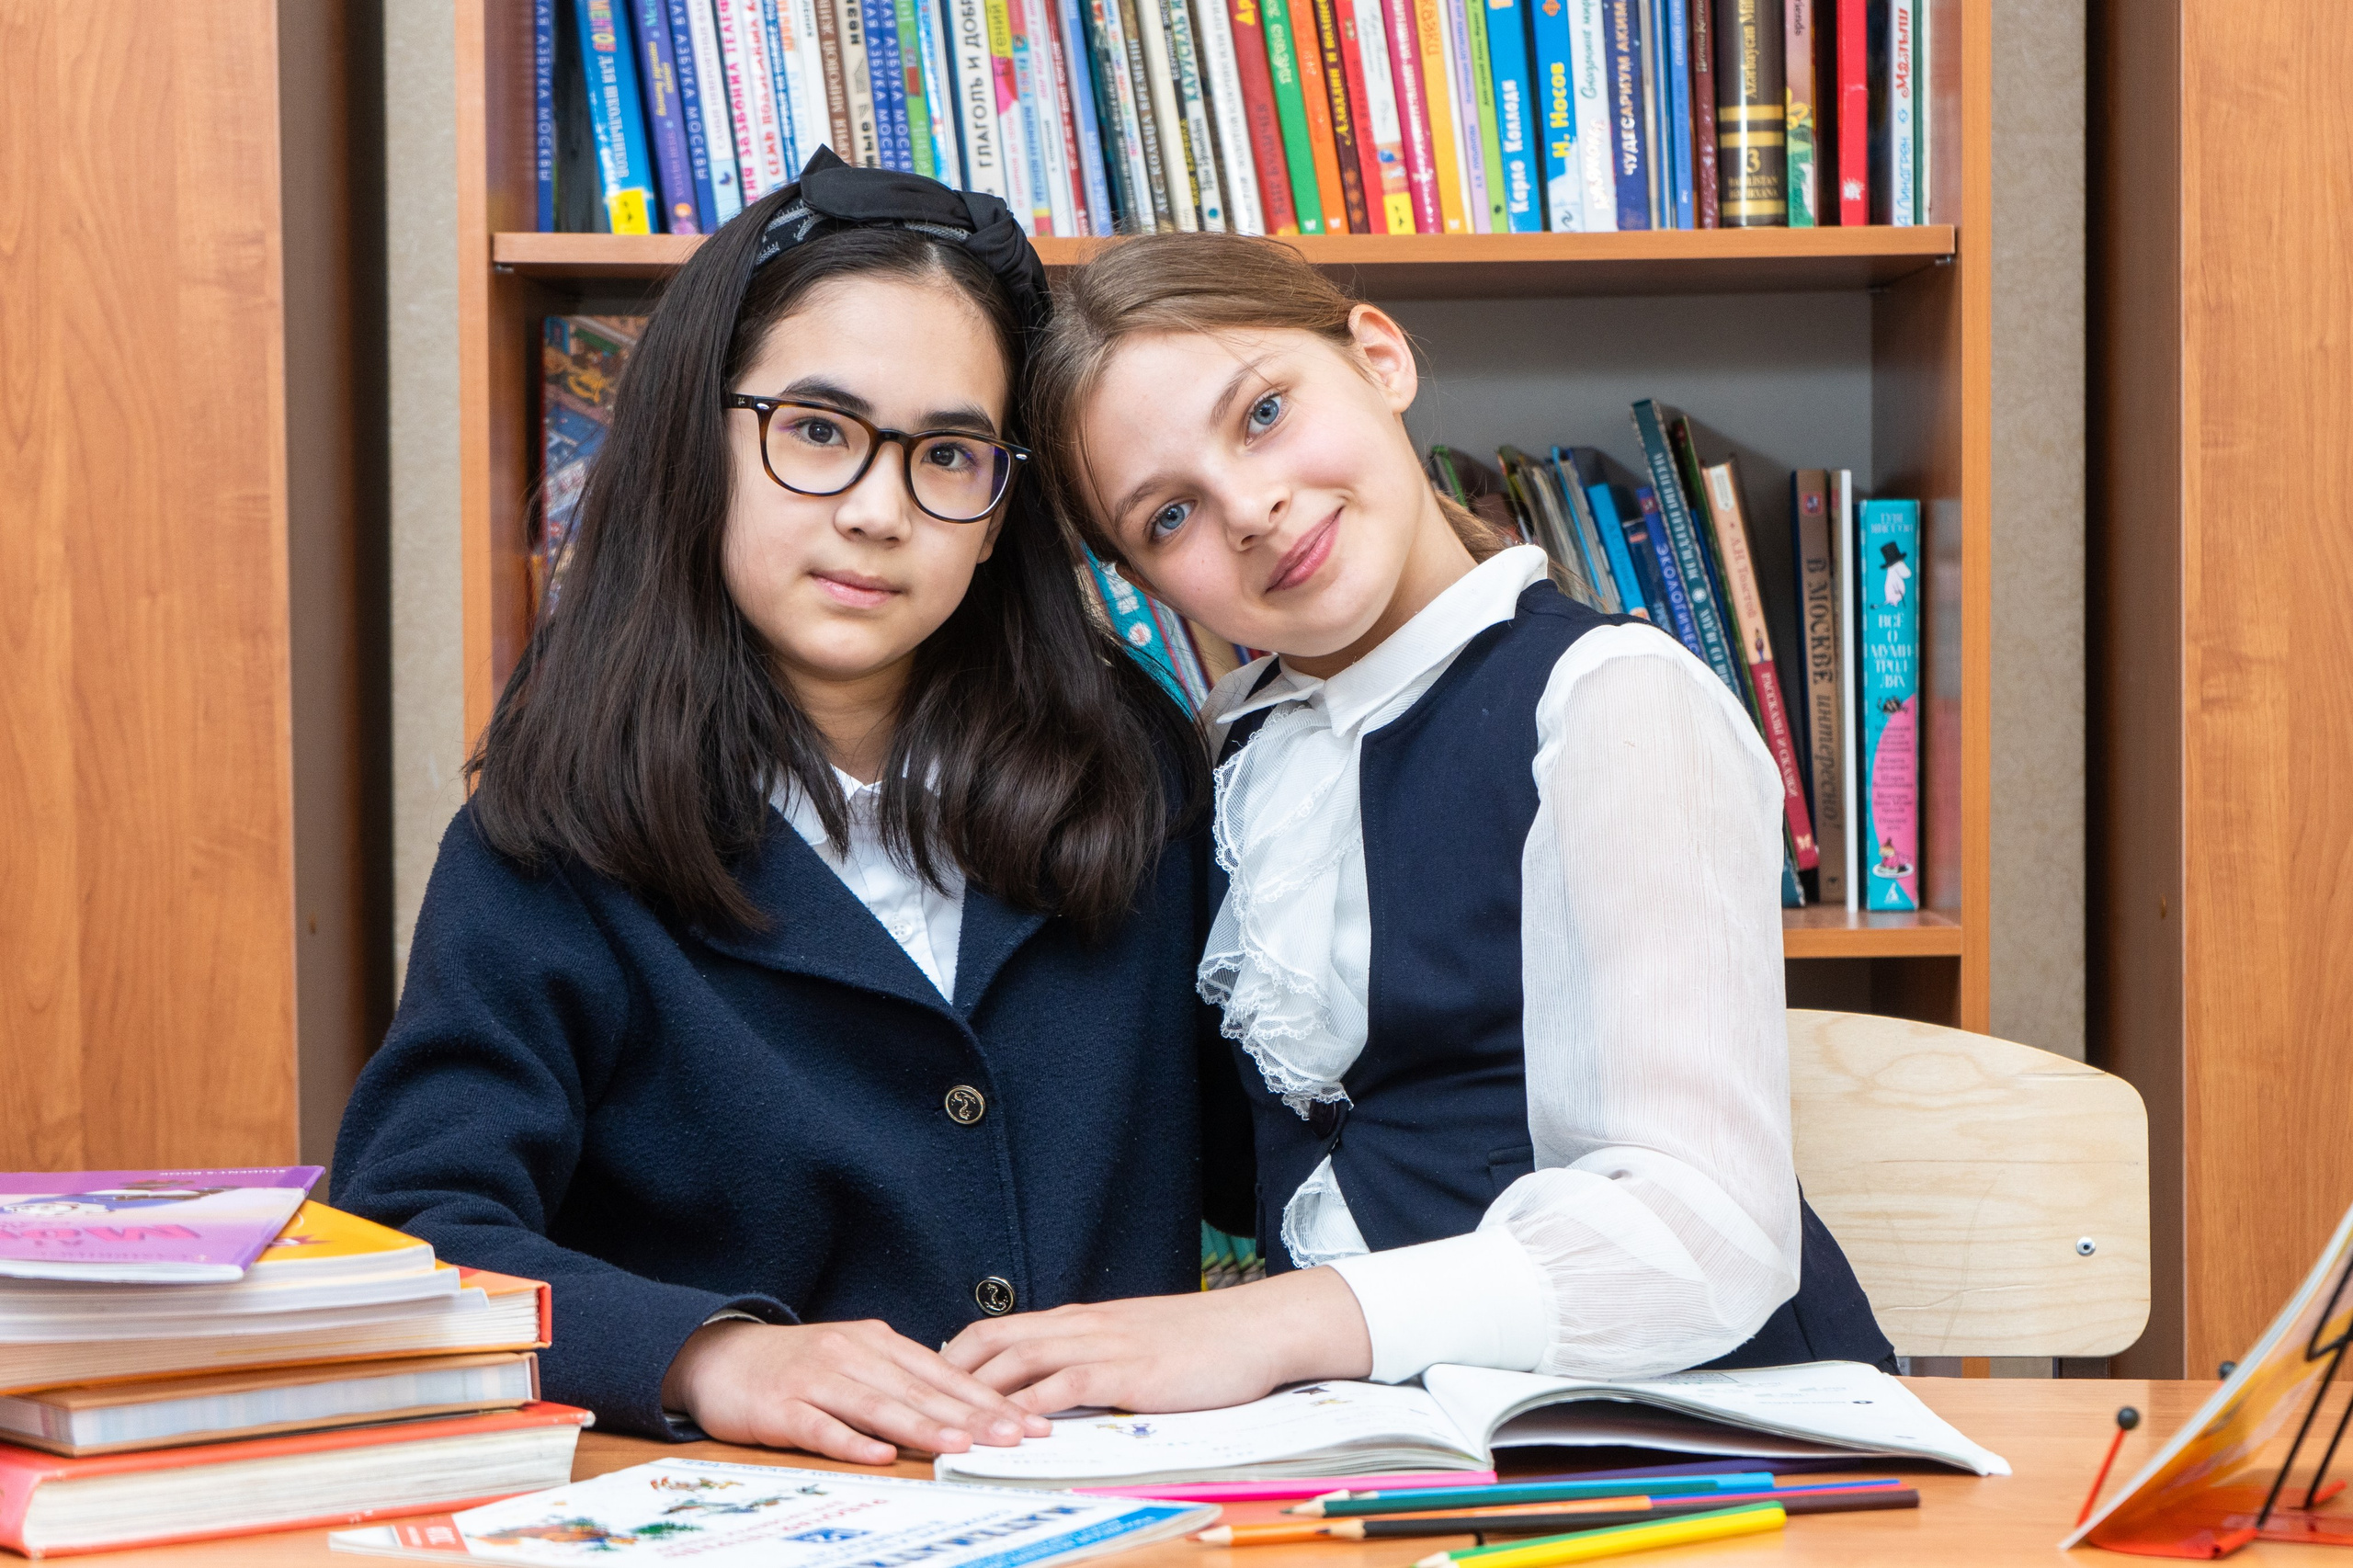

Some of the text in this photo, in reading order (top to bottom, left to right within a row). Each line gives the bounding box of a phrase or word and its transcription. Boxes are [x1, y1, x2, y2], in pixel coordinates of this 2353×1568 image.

[537, 34, 550, 99] АЗБУКА
[597, 55, 615, 83] ДЛЯ
[825, 40, 845, 112] МИРОВОЙ
[870, 36, 886, 101] АЗБУКА
[885, 36, 903, 101] АЗБУКА
[968, 56, 980, 70] И
[1165, 28, 1180, 80] БЕЗУМНЫЕ
[1326, 51, 1339, 62] и
[1895, 7, 1909, 98] Малыш
[601, 85, 631, 178] ШКОЛЬНИКОВ
[675, 34, 696, 97] АЗБУКА
[686, 106, 707, 179] МОСКВЫ
[970, 78, 993, 168] ГЛАГОЛЪ
[1329, 68, 1353, 145] Аладдин
[1550, 62, 1571, 158] Н. Носов
[1619, 55, 1636, 175] ЧУДЕСАРИУМ
[539, 108, 551, 181] МОСКВЫ
[762, 131, 779, 176] СЕМЬ
[1501, 80, 1529, 213] Карло Коллоди
[1745, 148, 1761, 174] 3
[1736, 566, 1757, 619] Толстой
[1805, 557, 1840, 829] В МОСКВЕ интересно!
[1761, 673, 1784, 734] РАССКАЗЫ
[1778, 748, 1799, 798] СКАЗКИ
